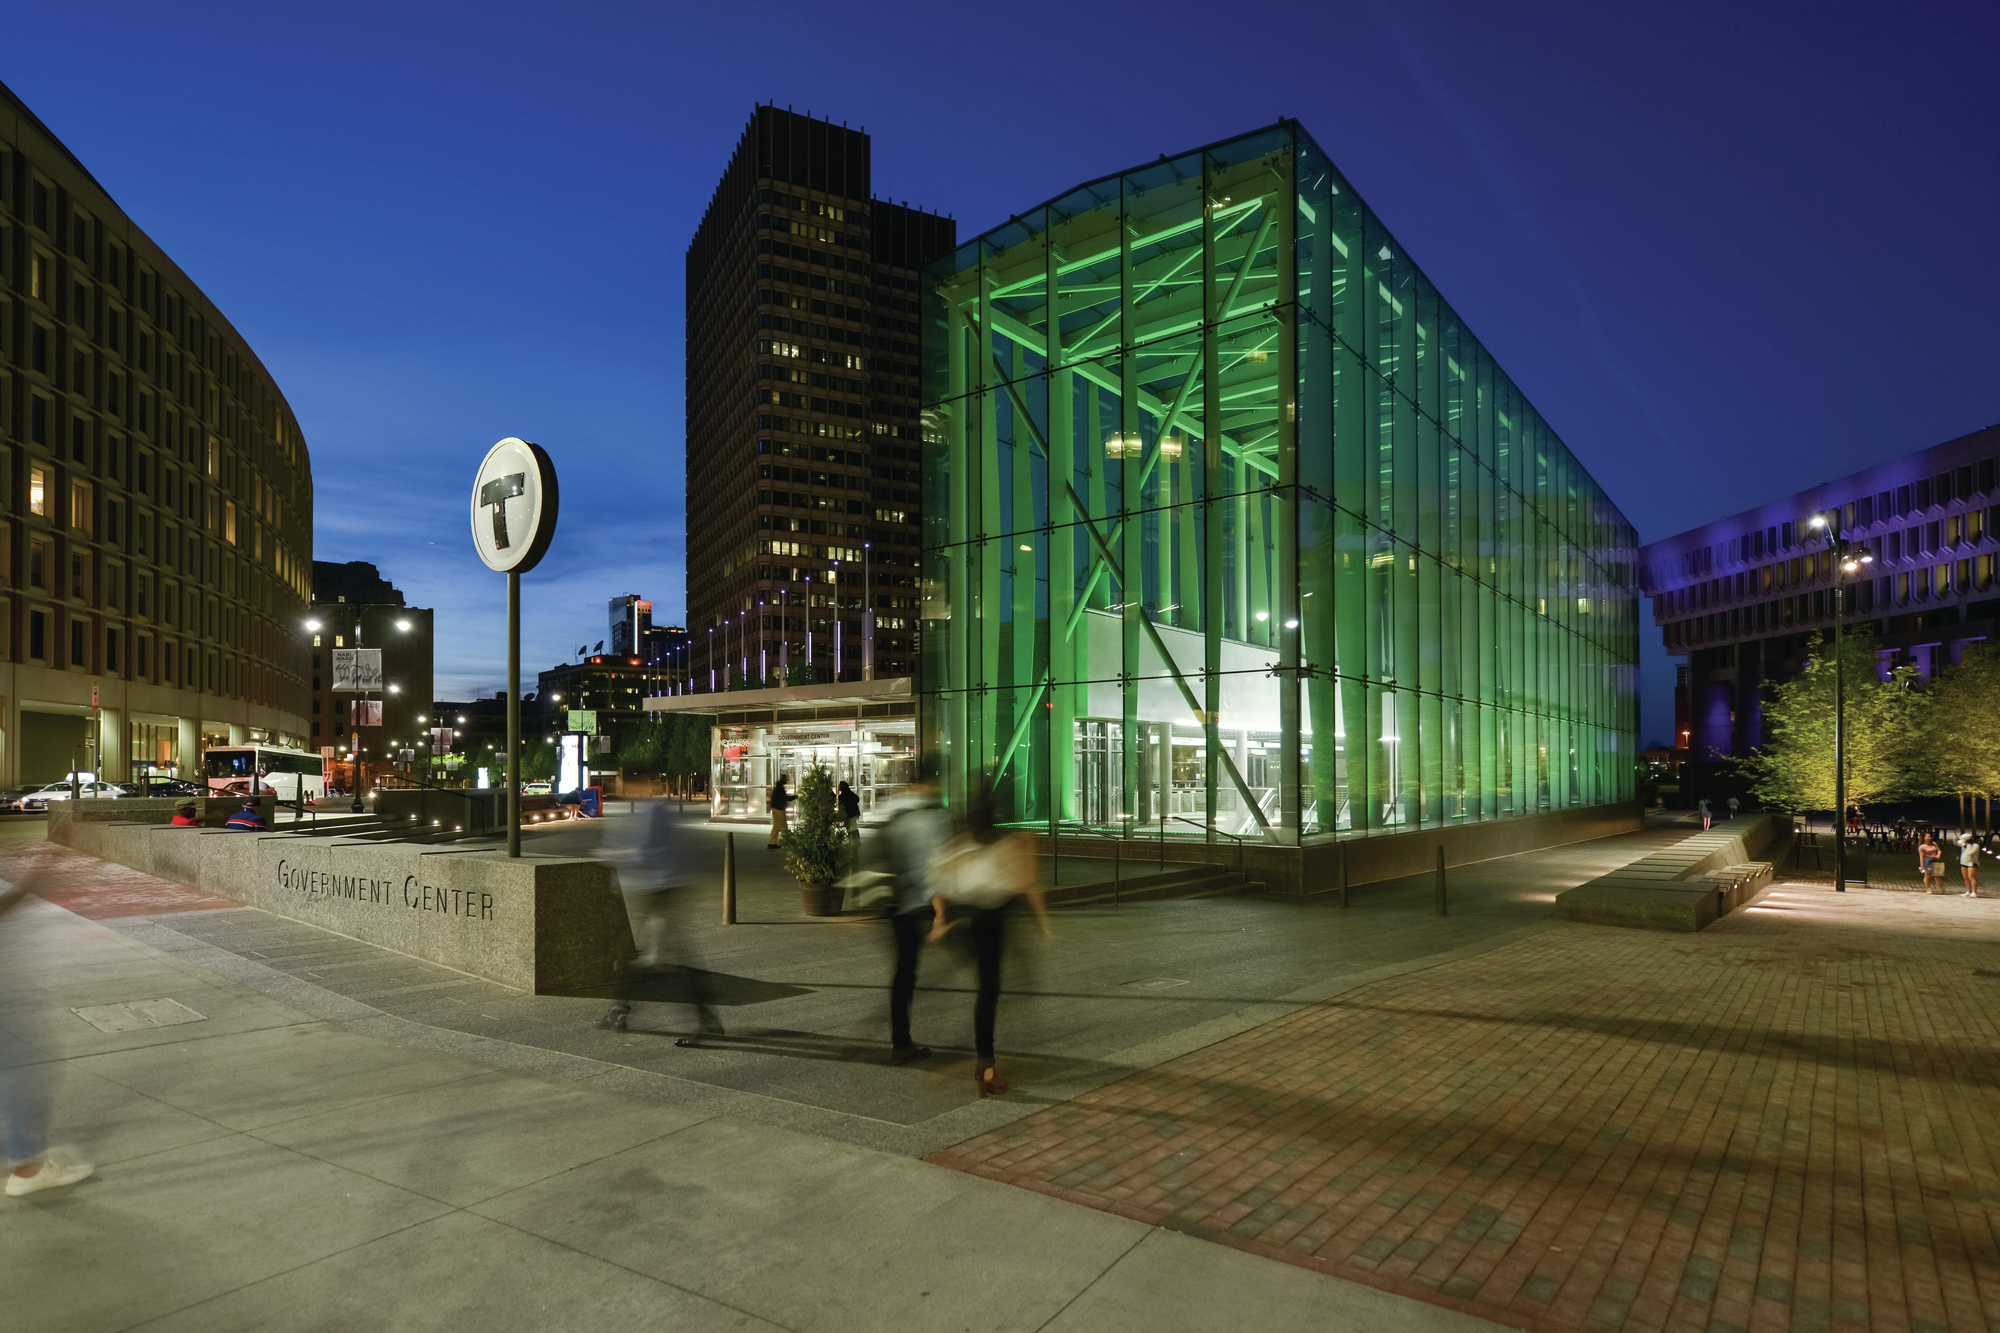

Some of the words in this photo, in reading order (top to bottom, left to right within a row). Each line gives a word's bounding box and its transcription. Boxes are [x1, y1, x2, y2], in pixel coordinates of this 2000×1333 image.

[480, 472, 525, 550] T
[278, 859, 392, 905] GOVERNMENT
[404, 875, 493, 921] CENTER
